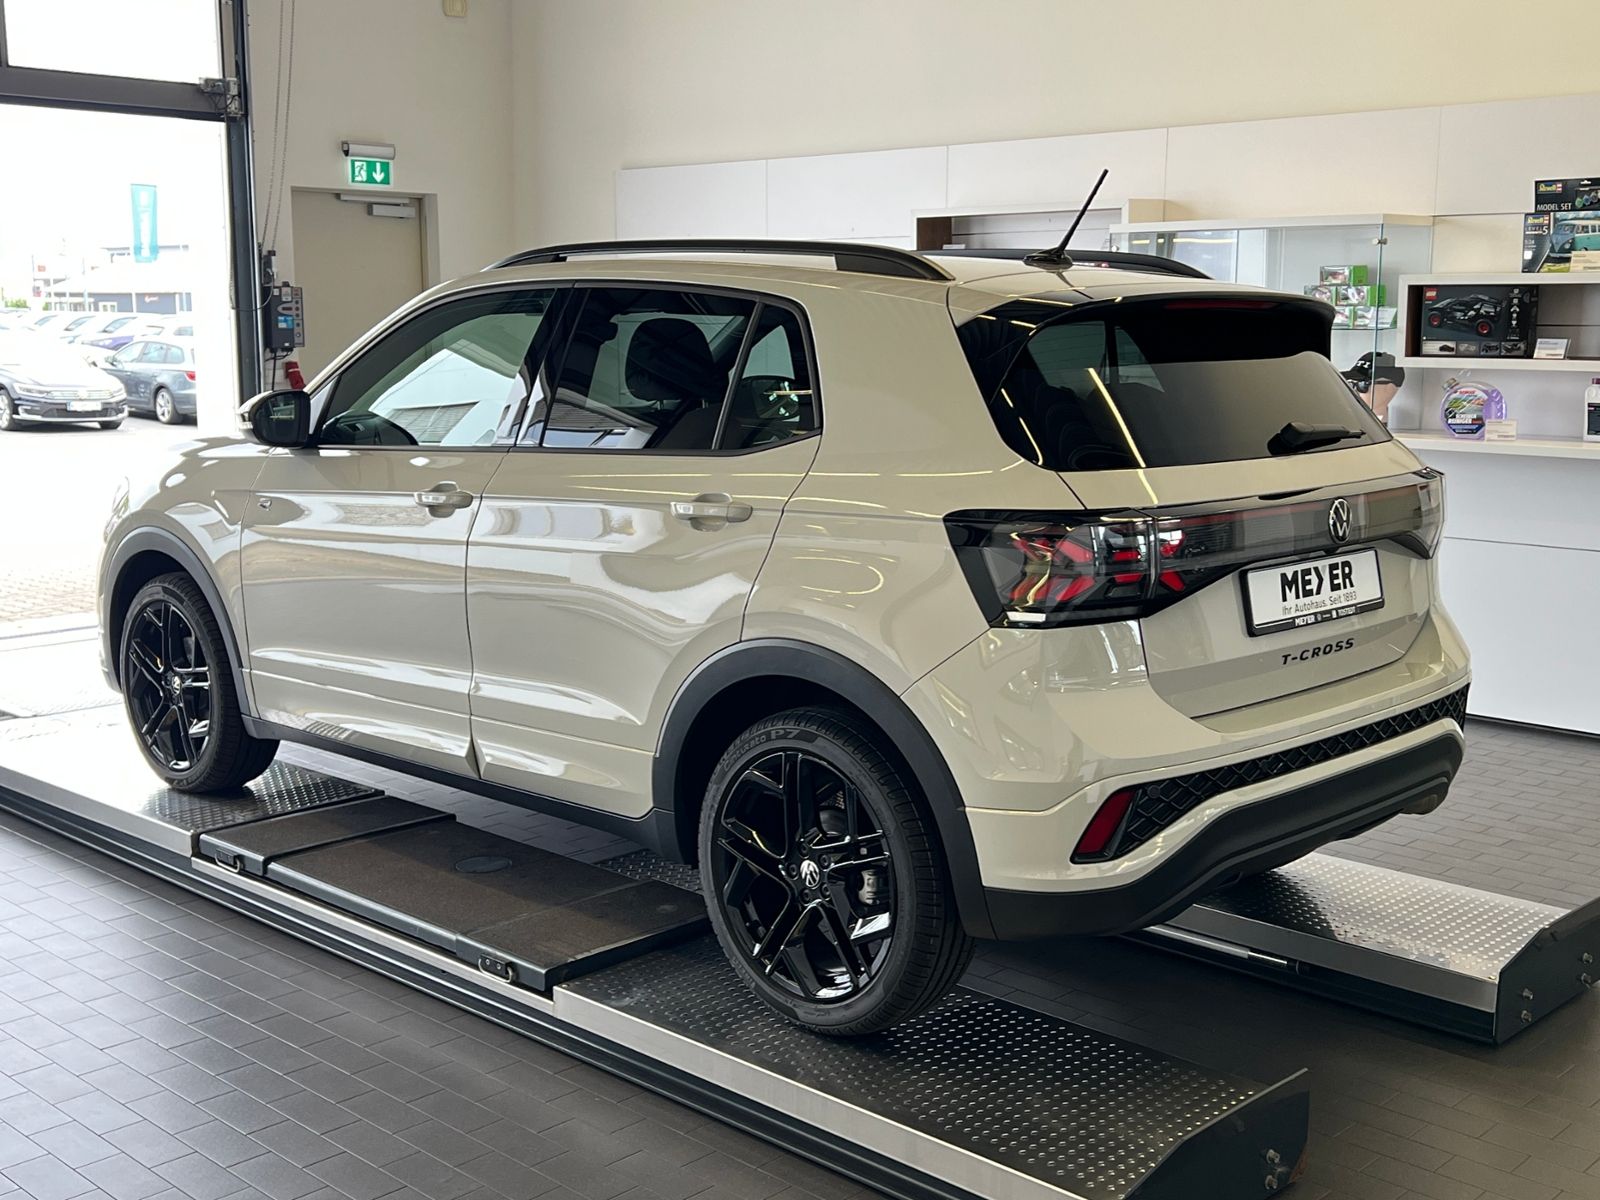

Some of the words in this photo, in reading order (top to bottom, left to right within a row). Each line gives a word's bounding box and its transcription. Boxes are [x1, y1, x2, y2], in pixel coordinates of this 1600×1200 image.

[1536, 203, 1559, 211] MODEL
[1542, 226, 1549, 235] 5
[1280, 560, 1355, 603] MEYER
[1282, 605, 1293, 616] Ihr
[1294, 599, 1328, 614] Autohaus.
[1328, 594, 1342, 606] Seit
[1342, 591, 1357, 603] 1893
[1282, 638, 1355, 665] T-CROSS
[770, 728, 801, 739] P7
